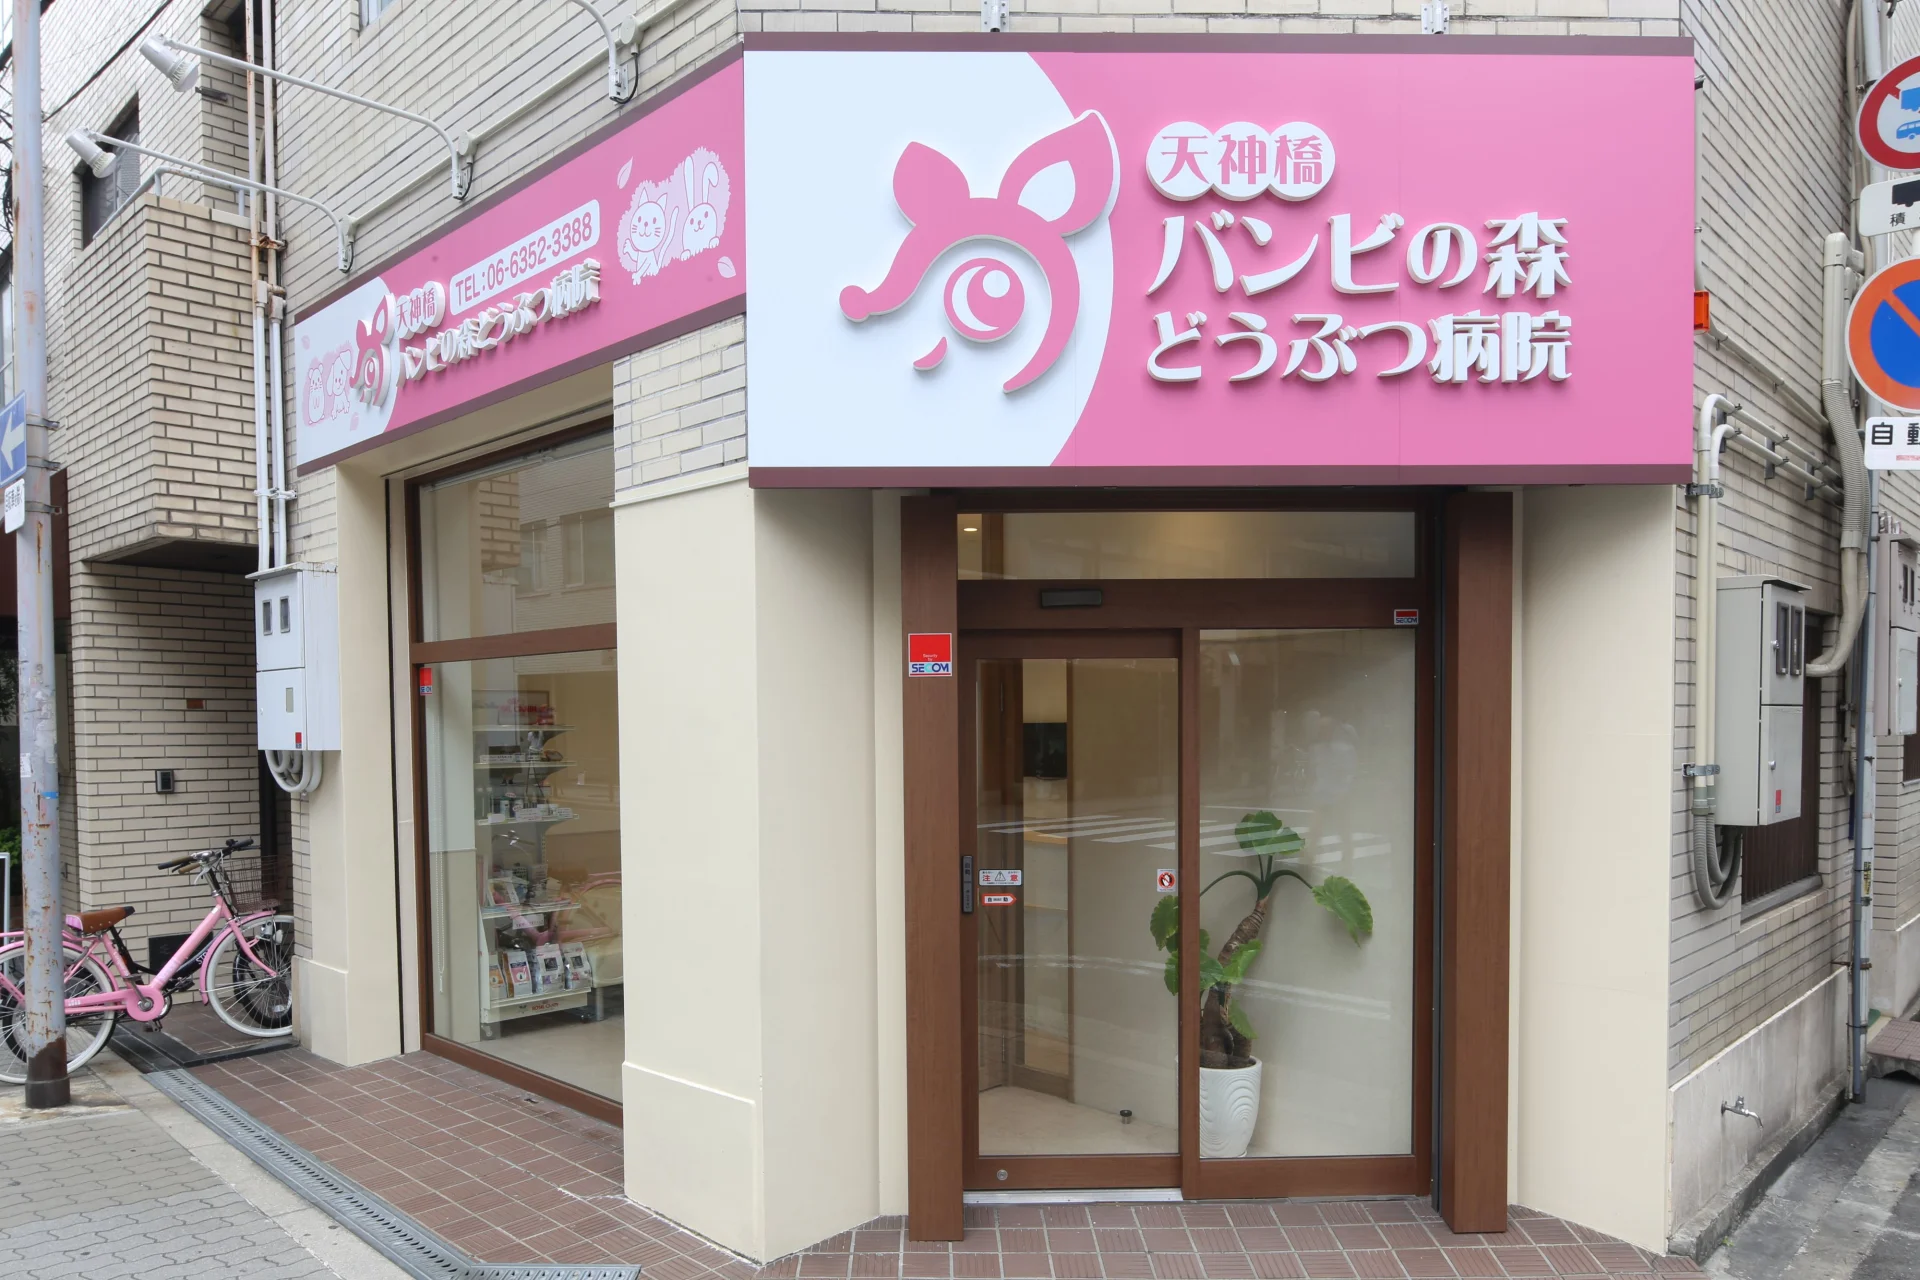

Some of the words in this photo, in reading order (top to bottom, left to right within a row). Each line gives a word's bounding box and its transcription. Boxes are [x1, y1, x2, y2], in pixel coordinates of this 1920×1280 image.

[1158, 133, 1325, 187] 天神橋
[455, 211, 593, 307] TEL:06-6352-3388
[1145, 209, 1573, 299] バンビの森
[396, 286, 437, 333] 天神橋
[1146, 309, 1573, 385] どうぶつ病院
[911, 662, 949, 673] SECOM
